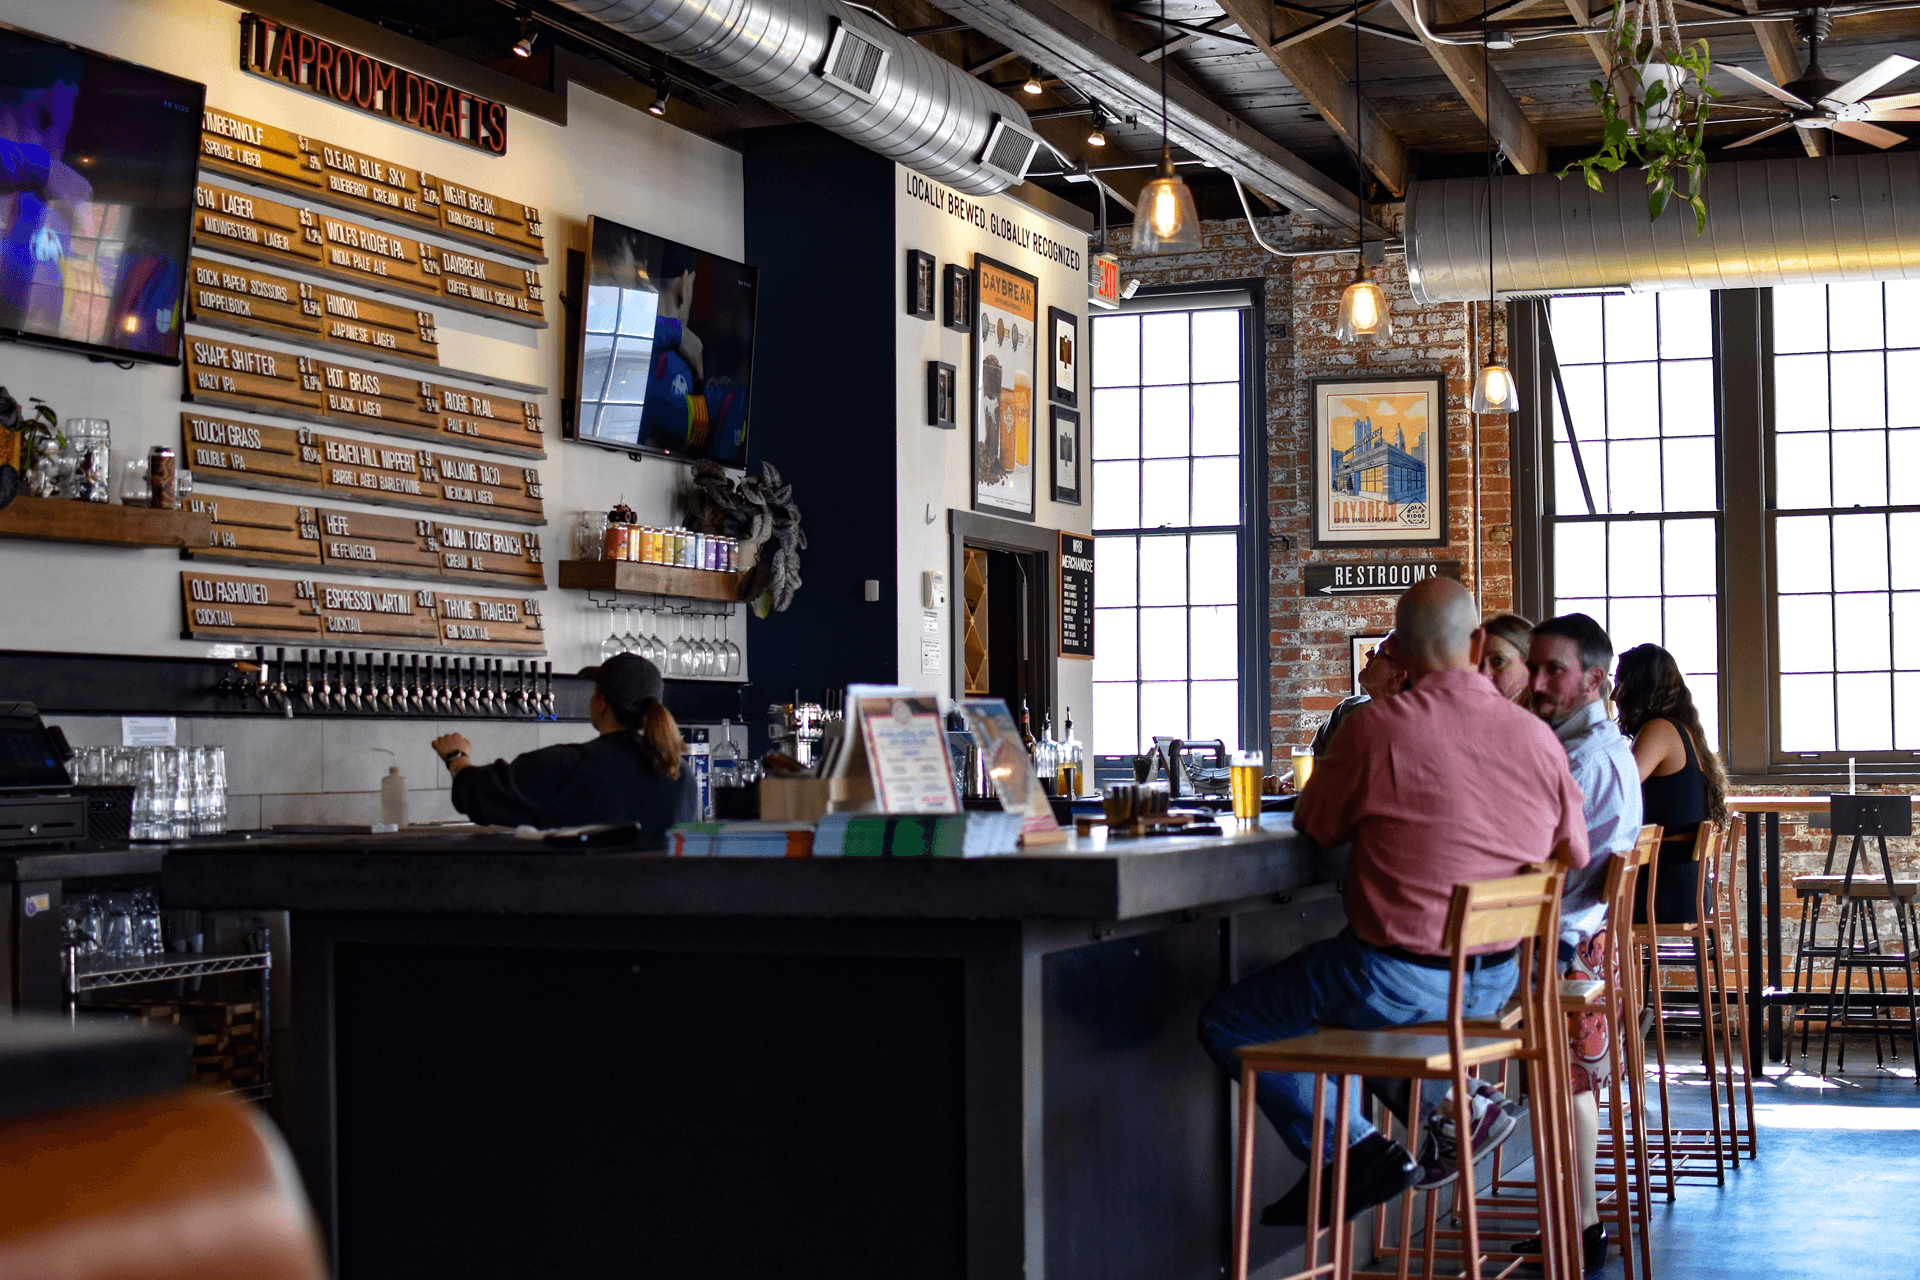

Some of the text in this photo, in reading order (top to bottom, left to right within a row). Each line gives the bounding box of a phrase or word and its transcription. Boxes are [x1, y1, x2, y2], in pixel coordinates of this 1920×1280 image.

[259, 18, 504, 151] TAPROOM DRAFTS
[204, 139, 262, 168] SPRUCE LAGER
[324, 147, 406, 188] CLEAR BLUE SKY
[197, 186, 254, 219] 614 LAGER
[329, 175, 418, 213] BLUEBERRY CREAM ALE
[443, 185, 495, 216] NIGHT BREAK
[204, 216, 290, 251] MIDWESTERN LAGER
[484, 221, 496, 235] ALE
[529, 222, 541, 236] 5.0
[906, 172, 945, 210] LOCALLY
[991, 213, 1030, 250] GLOBALLY
[1033, 232, 1080, 271] RECOGNIZED
[326, 220, 405, 259] WOLFS RIDGE IPA
[331, 248, 388, 276] INDIA PALE ALE
[443, 253, 486, 280] DAYBREAK
[197, 267, 288, 301] BOCK PAPER SCISSORS
[983, 272, 1032, 306] DAYBREAK
[1099, 259, 1117, 300] EXIT
[199, 291, 252, 316] DOPPELBOCK
[326, 294, 359, 319] HINOKI
[447, 279, 530, 312] COFFEE VANILLA CREAM ALE
[332, 322, 396, 348] JAPANESE LAGER
[194, 342, 276, 376] SHAPE SHIFTER
[198, 372, 236, 393] HAZY IPA
[326, 367, 380, 395] HOT BRASS
[329, 394, 382, 417] BLACK LAGER
[444, 391, 494, 418] RIDGE TRAIL
[192, 420, 261, 449] TOUCH GRASS
[447, 418, 480, 436] PALE ALE
[197, 449, 246, 470] DOUBLE IPA
[326, 441, 360, 464] HEAVEN
[360, 446, 380, 467] HILL
[332, 469, 422, 494] BARREL AGED BARLEYWINE
[441, 459, 500, 485] WALKING TACO
[444, 485, 494, 504] MEXICAN LAGER
[327, 514, 350, 535] HEFE
[1334, 501, 1398, 523] DAYBREAK
[222, 532, 236, 547] IPA
[331, 542, 377, 560] HEFEWEIZEN
[469, 531, 492, 551] TOAST
[493, 534, 523, 555] BRUNCH
[445, 553, 484, 571] CREAM ALE
[1062, 554, 1093, 573] MERCHANDISE
[1335, 565, 1437, 586] RESTROOMS
[192, 579, 269, 604] OLD FASHIONED
[326, 588, 372, 611] ESPRESSO
[195, 608, 235, 626] COCKTAIL
[444, 599, 473, 619] THYME
[479, 602, 518, 622] TRAVELER
[328, 616, 363, 633] COCKTAIL
[446, 624, 490, 640] GIN COCKTAIL
